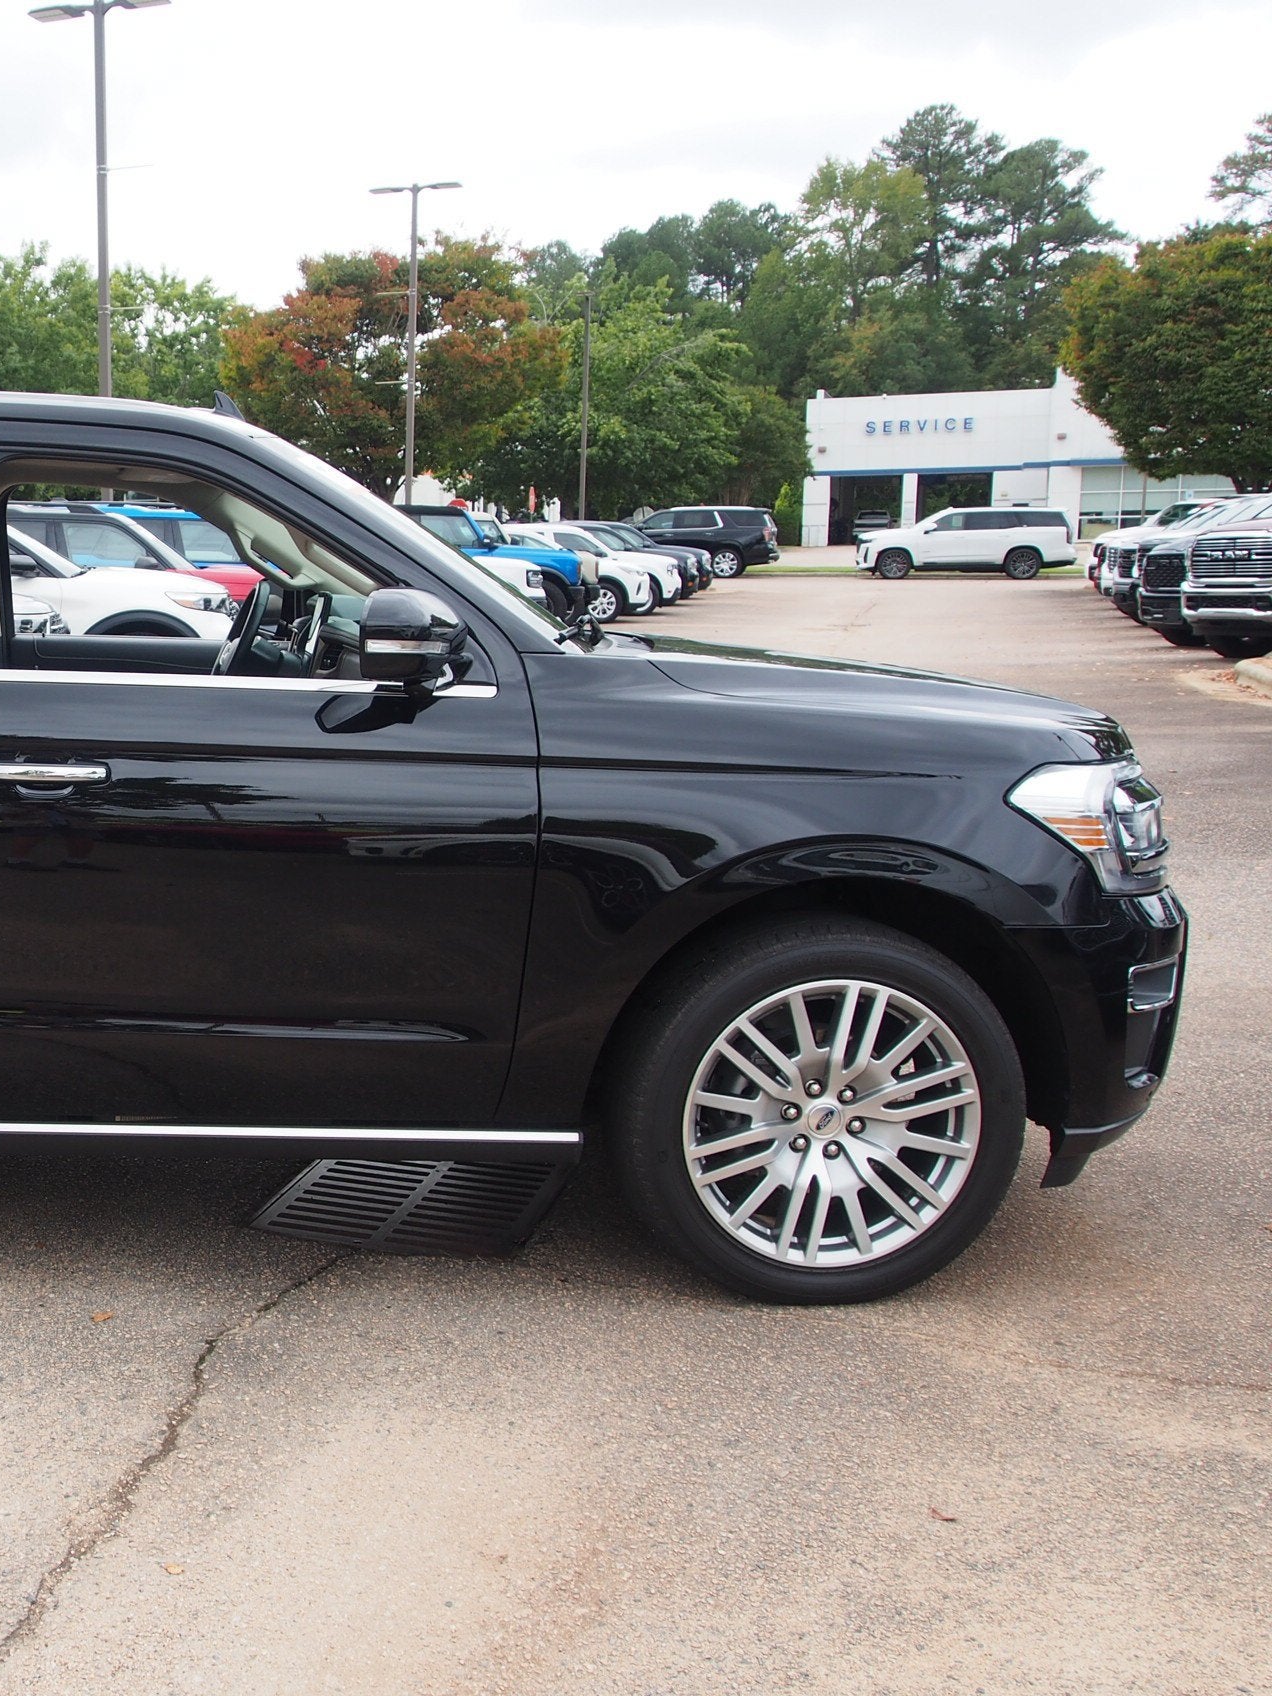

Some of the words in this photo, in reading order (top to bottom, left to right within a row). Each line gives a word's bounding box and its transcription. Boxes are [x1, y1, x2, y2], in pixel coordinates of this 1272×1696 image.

[865, 417, 974, 434] SERVICE
[1210, 550, 1250, 560] RAM
[816, 1110, 835, 1130] Ford
